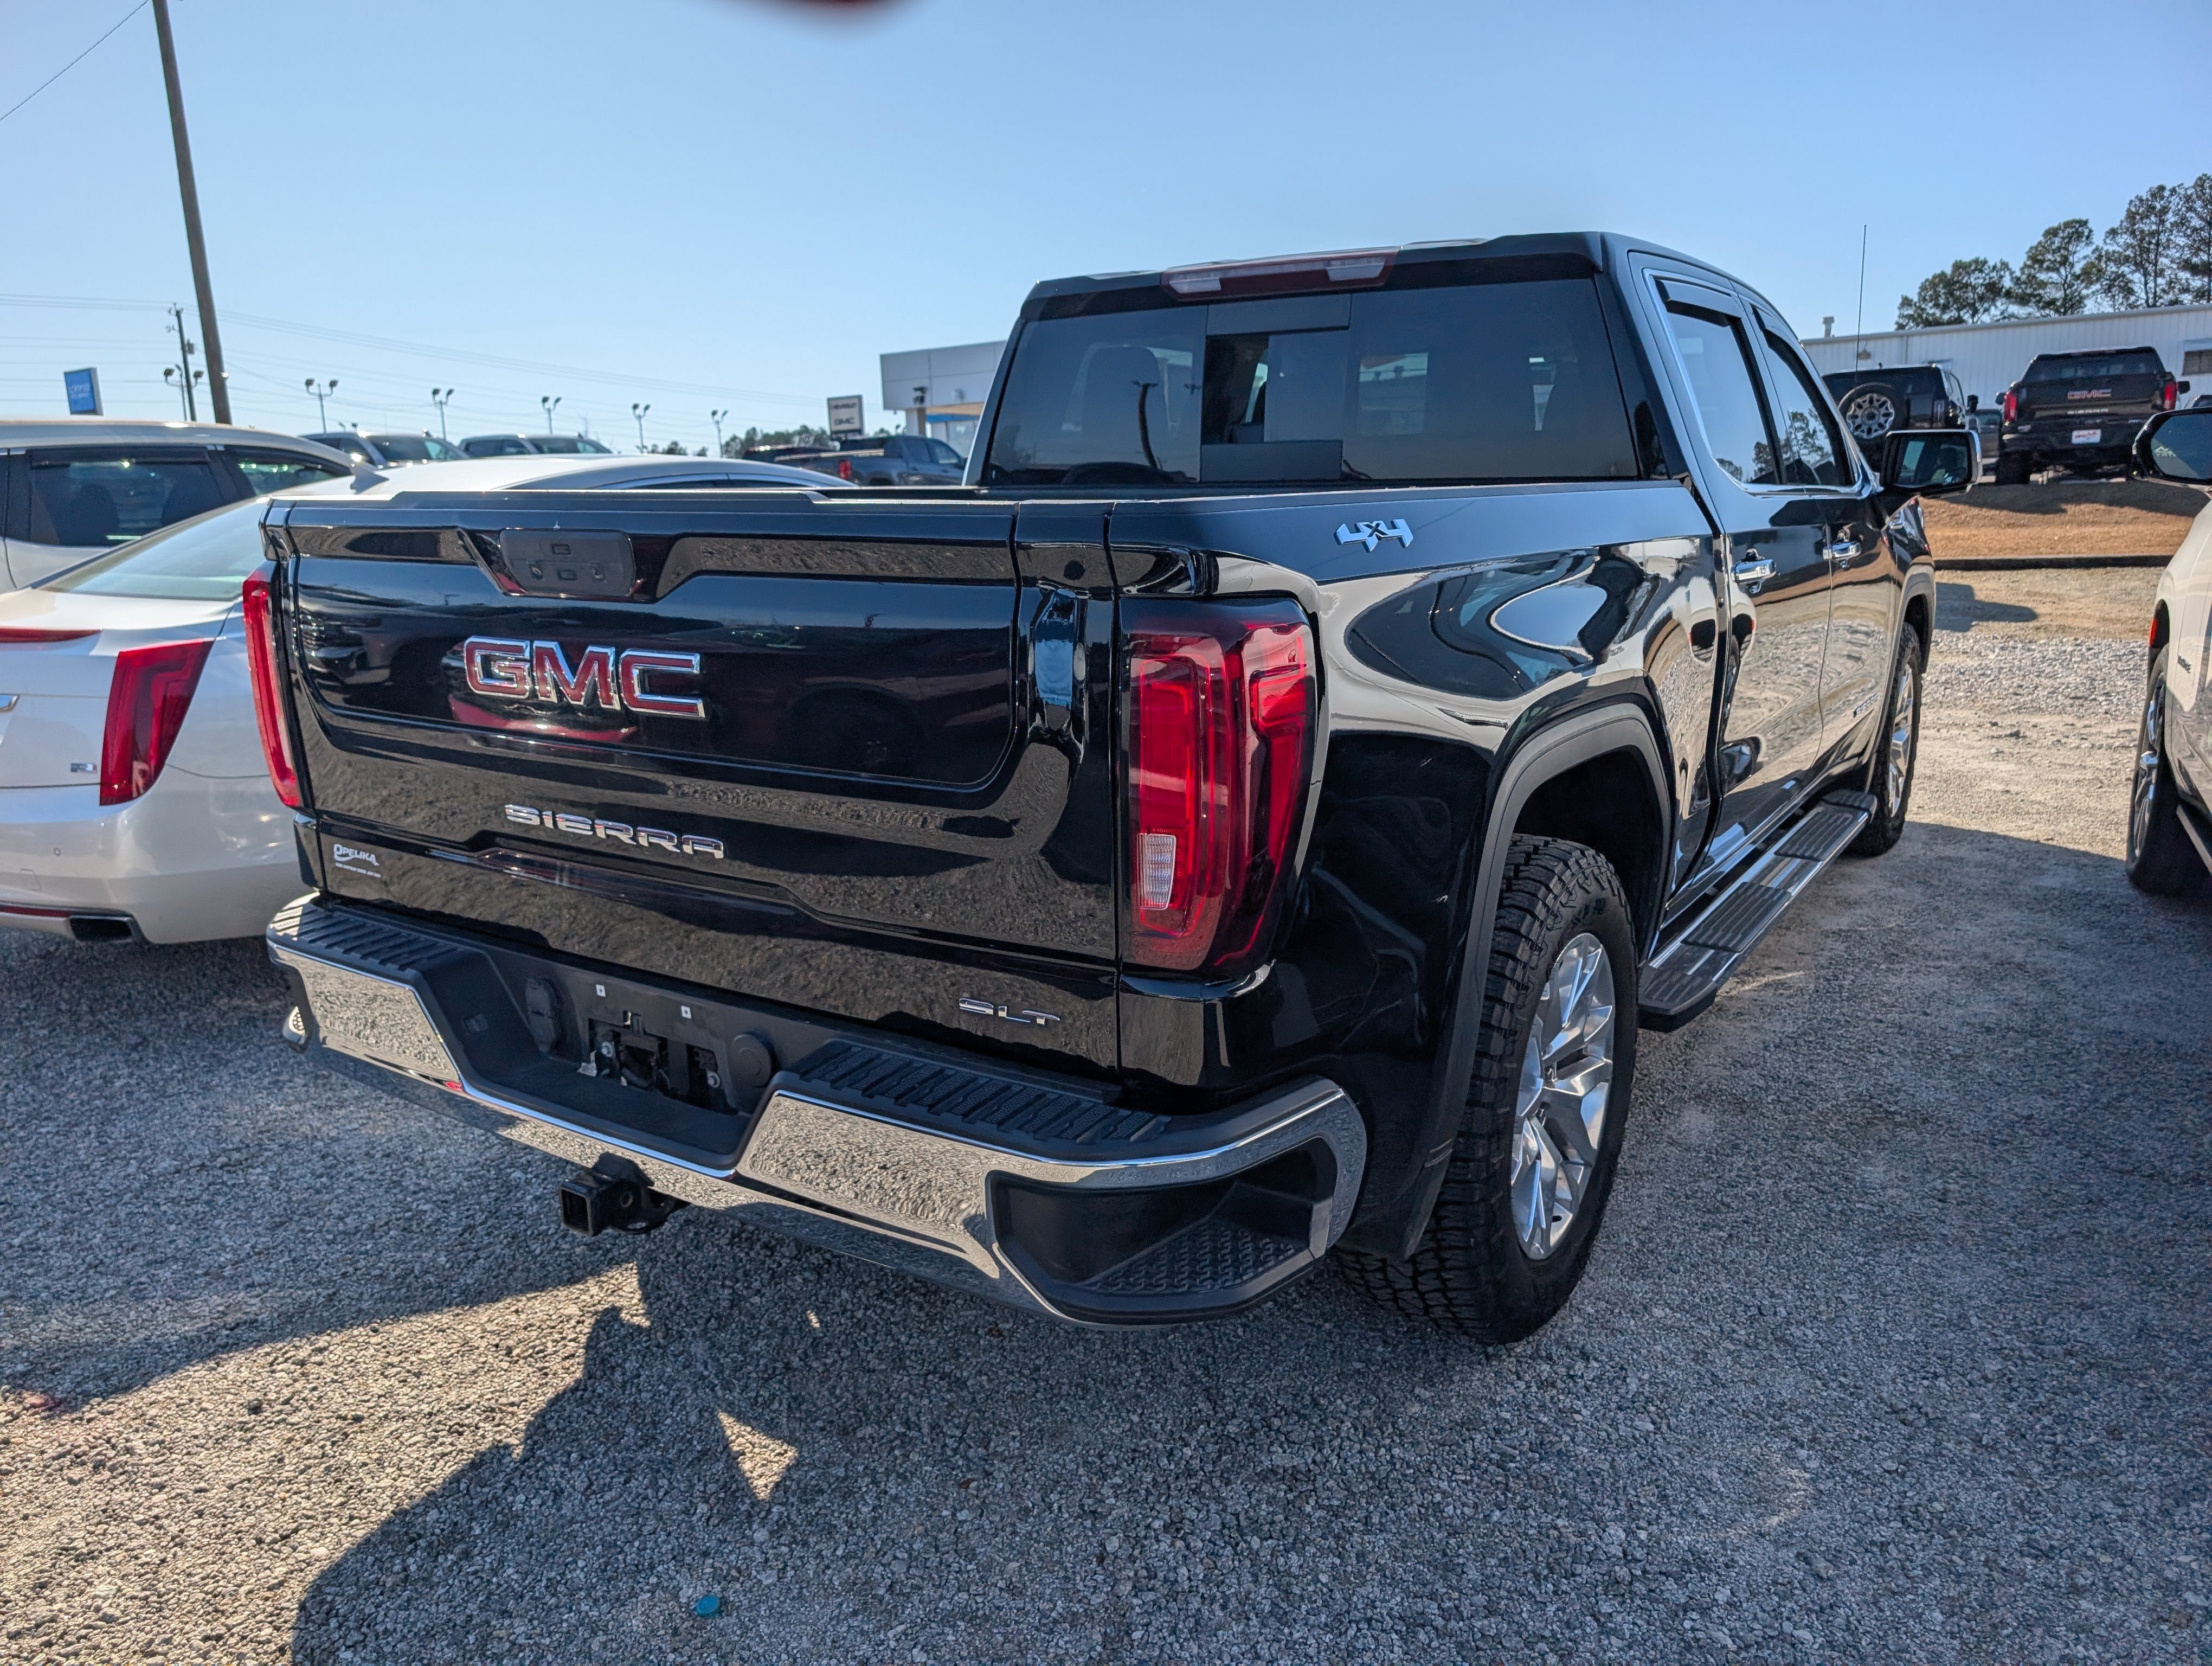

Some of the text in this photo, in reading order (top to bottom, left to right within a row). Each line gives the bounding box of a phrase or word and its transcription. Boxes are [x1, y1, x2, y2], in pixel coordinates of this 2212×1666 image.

[2067, 389, 2112, 400] GMC
[464, 635, 705, 718] GMC
[505, 804, 724, 859] SIERRA
[333, 843, 380, 866] OPELIKA
[959, 998, 1060, 1026] SLT
